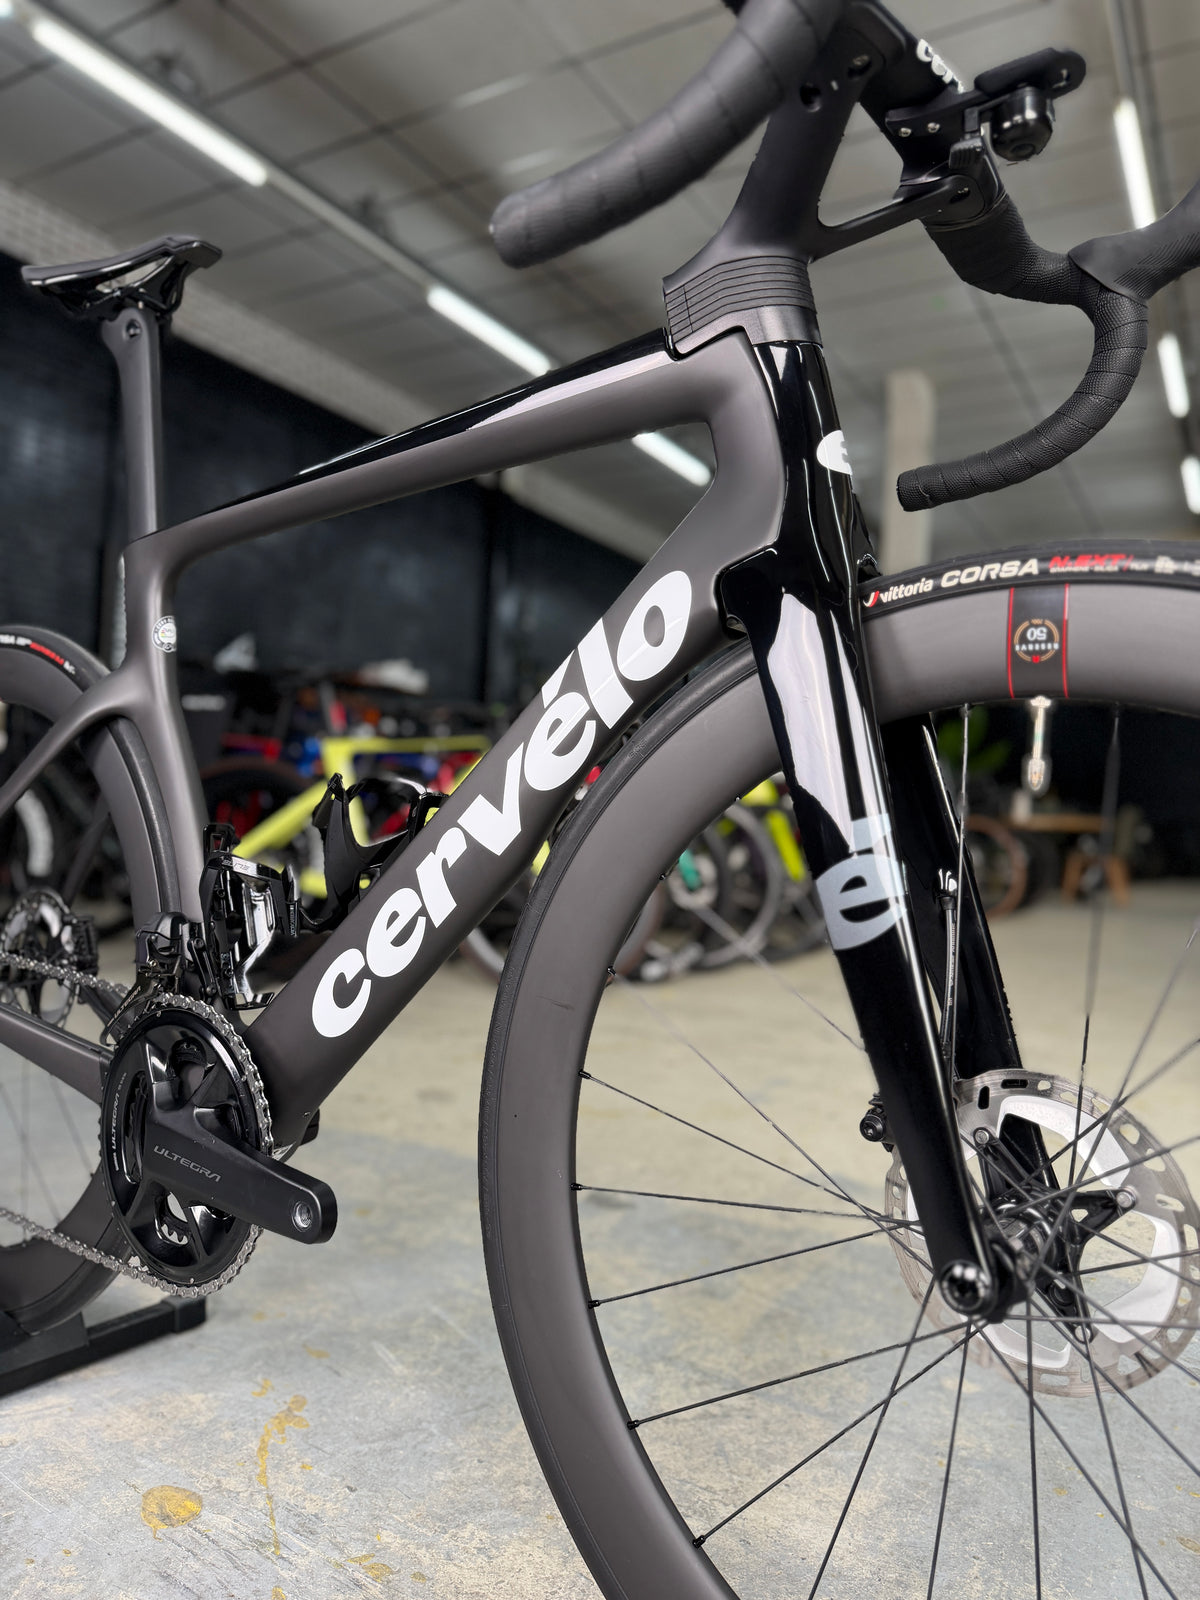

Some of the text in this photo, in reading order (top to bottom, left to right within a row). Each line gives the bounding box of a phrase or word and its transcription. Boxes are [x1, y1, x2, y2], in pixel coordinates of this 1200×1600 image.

[878, 577, 934, 603] vittoria
[940, 558, 1039, 588] CORSA
[1027, 627, 1048, 641] 50
[311, 570, 693, 1038] cervélo
[112, 1094, 121, 1150] ULTEGRA
[153, 1145, 222, 1183] ULTEGRA
